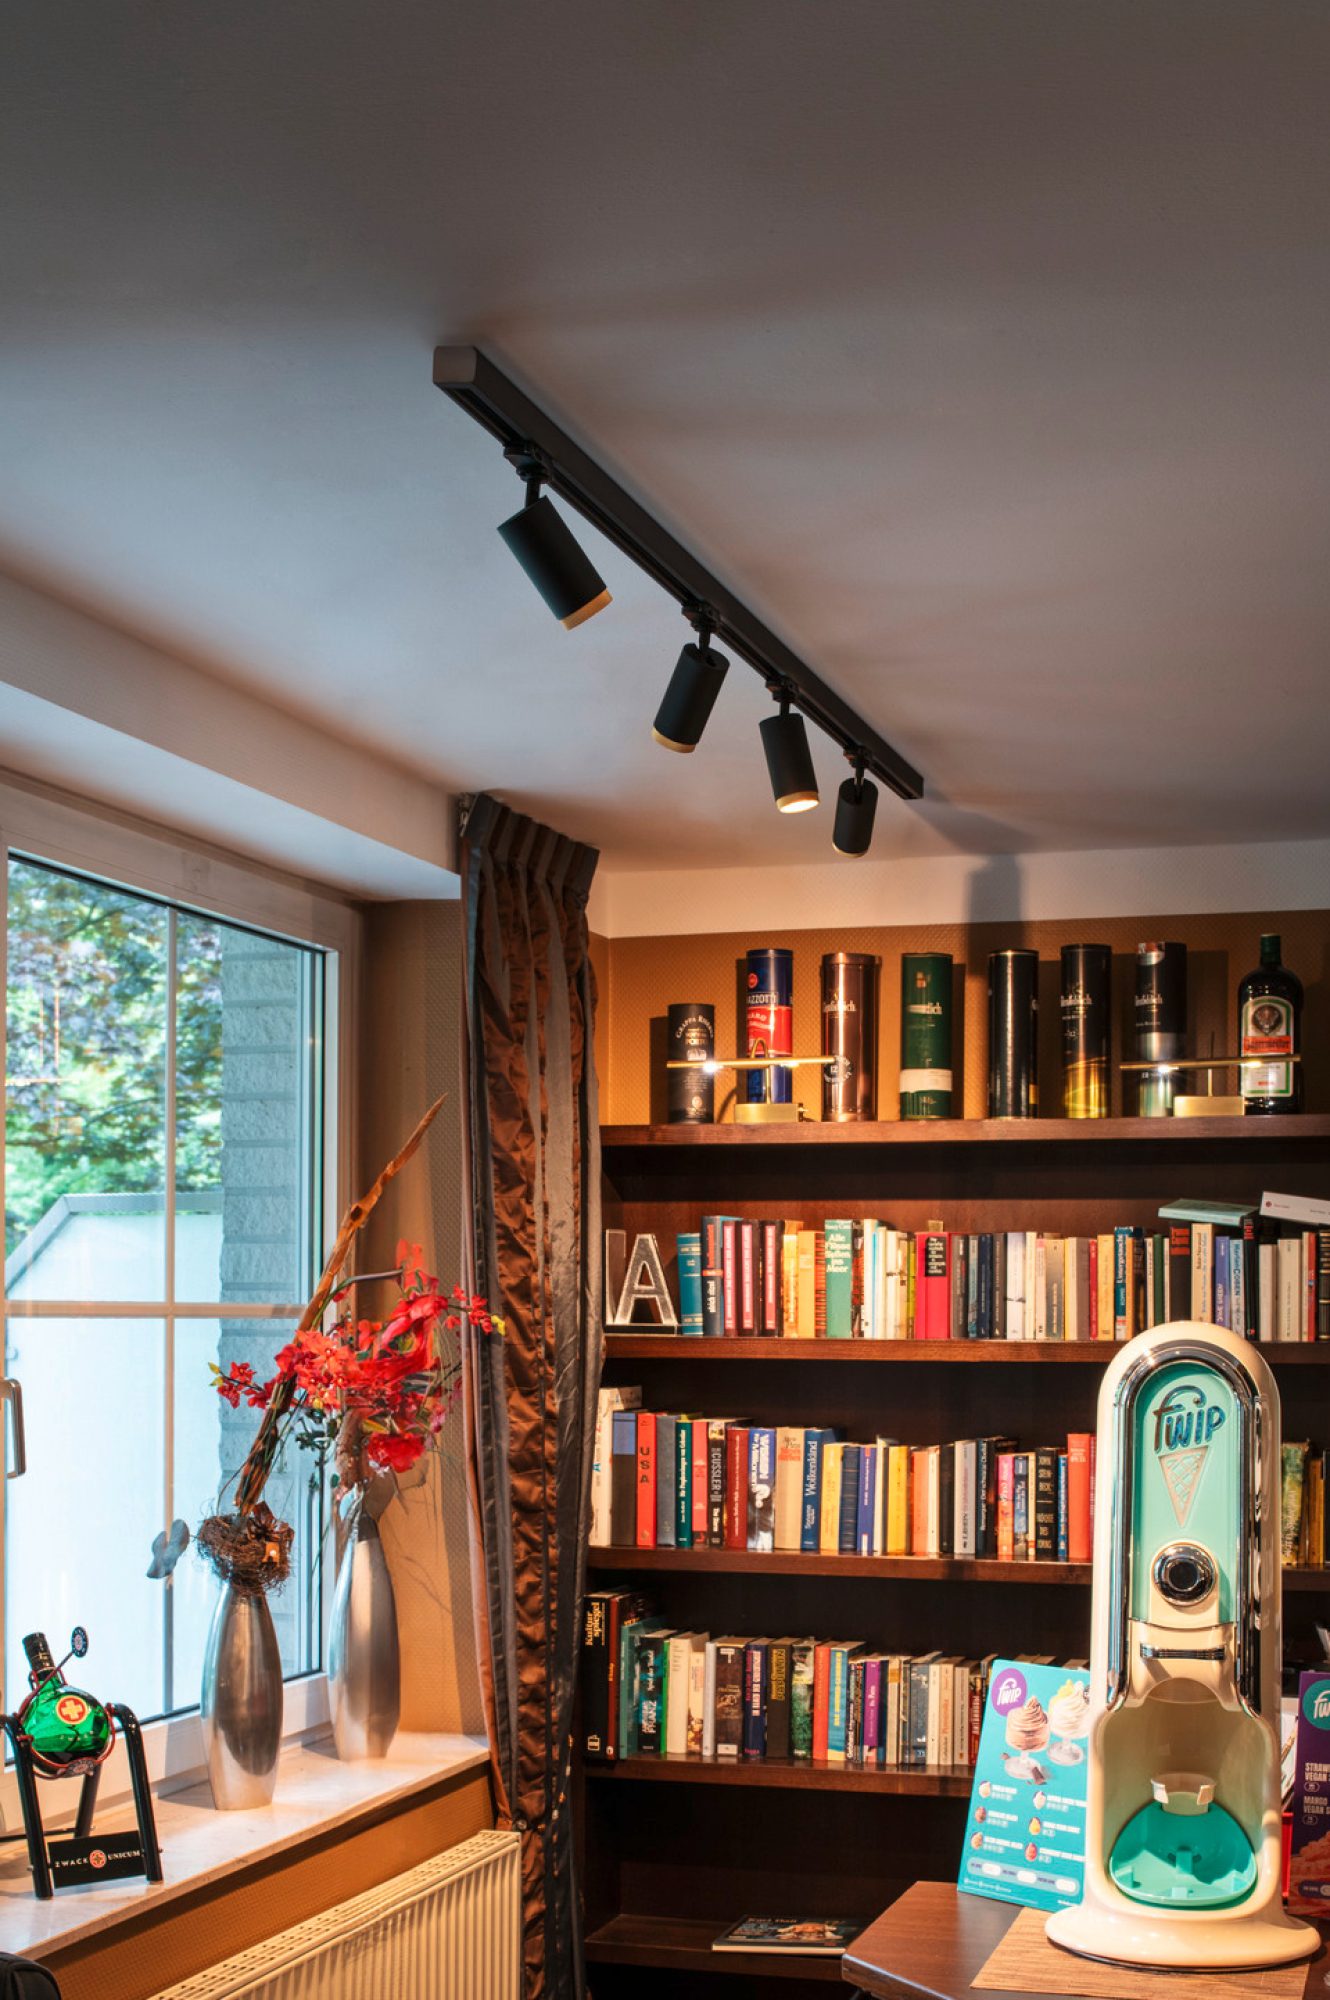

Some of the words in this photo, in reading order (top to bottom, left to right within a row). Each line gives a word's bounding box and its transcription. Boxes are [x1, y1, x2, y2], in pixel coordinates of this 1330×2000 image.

[711, 1452, 722, 1490] CUSSLER
[804, 1440, 818, 1496] Wolkenkind
[585, 1611, 594, 1646] Kultur
[591, 1601, 602, 1638] spiegel
[648, 1700, 657, 1734] FRANZ
[54, 1857, 88, 1868] ZWACK
[107, 1849, 141, 1861] UNICUM
